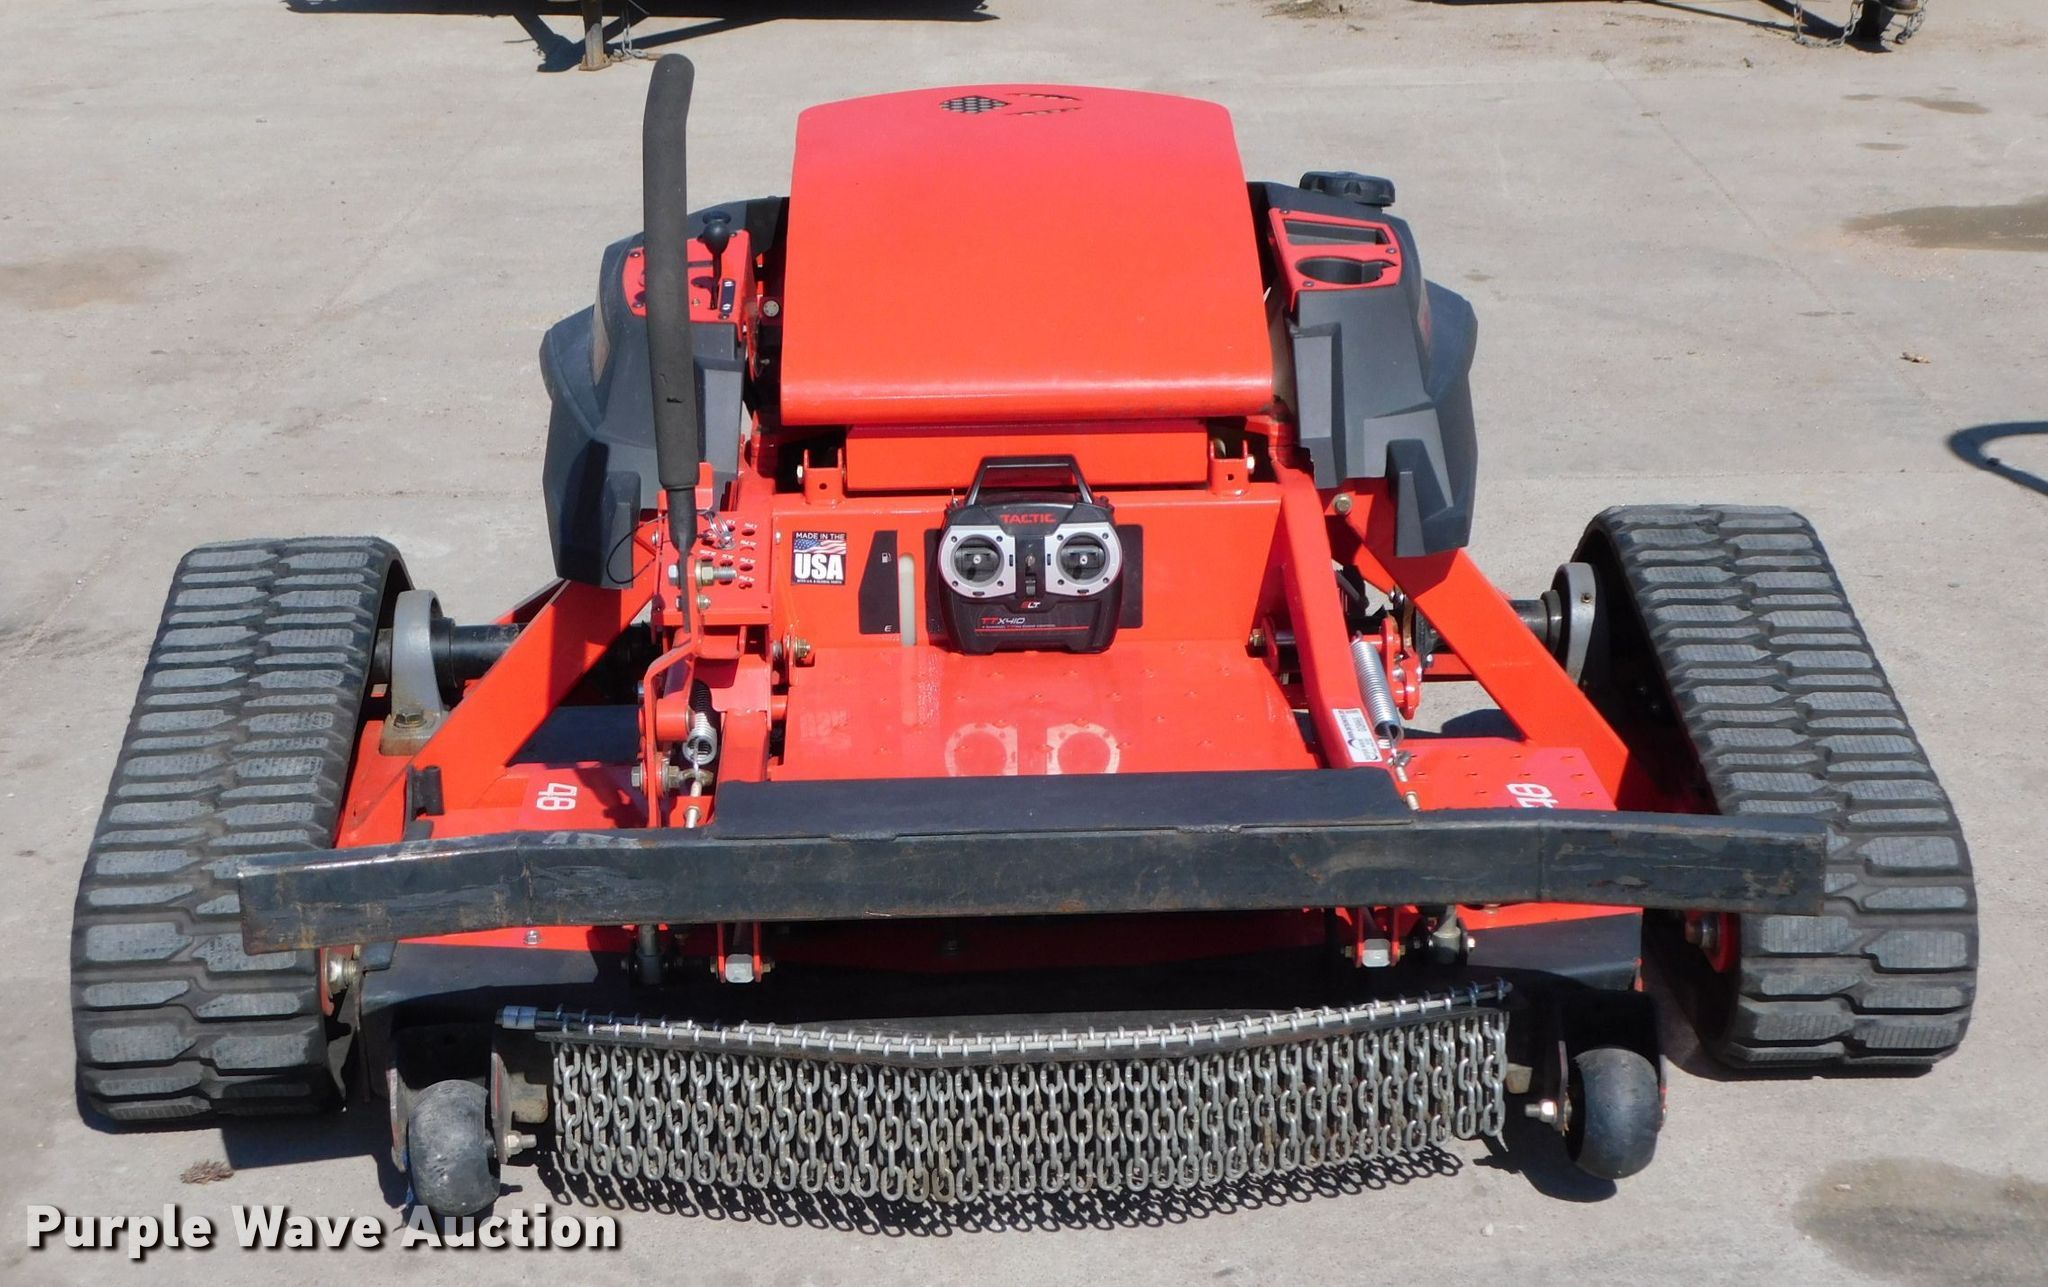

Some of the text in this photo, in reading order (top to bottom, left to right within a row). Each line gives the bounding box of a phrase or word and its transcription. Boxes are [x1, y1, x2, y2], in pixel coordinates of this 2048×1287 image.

[1001, 513, 1056, 524] TACTIC
[796, 532, 818, 540] MADE
[795, 553, 844, 580] USA
[536, 782, 577, 810] 48
